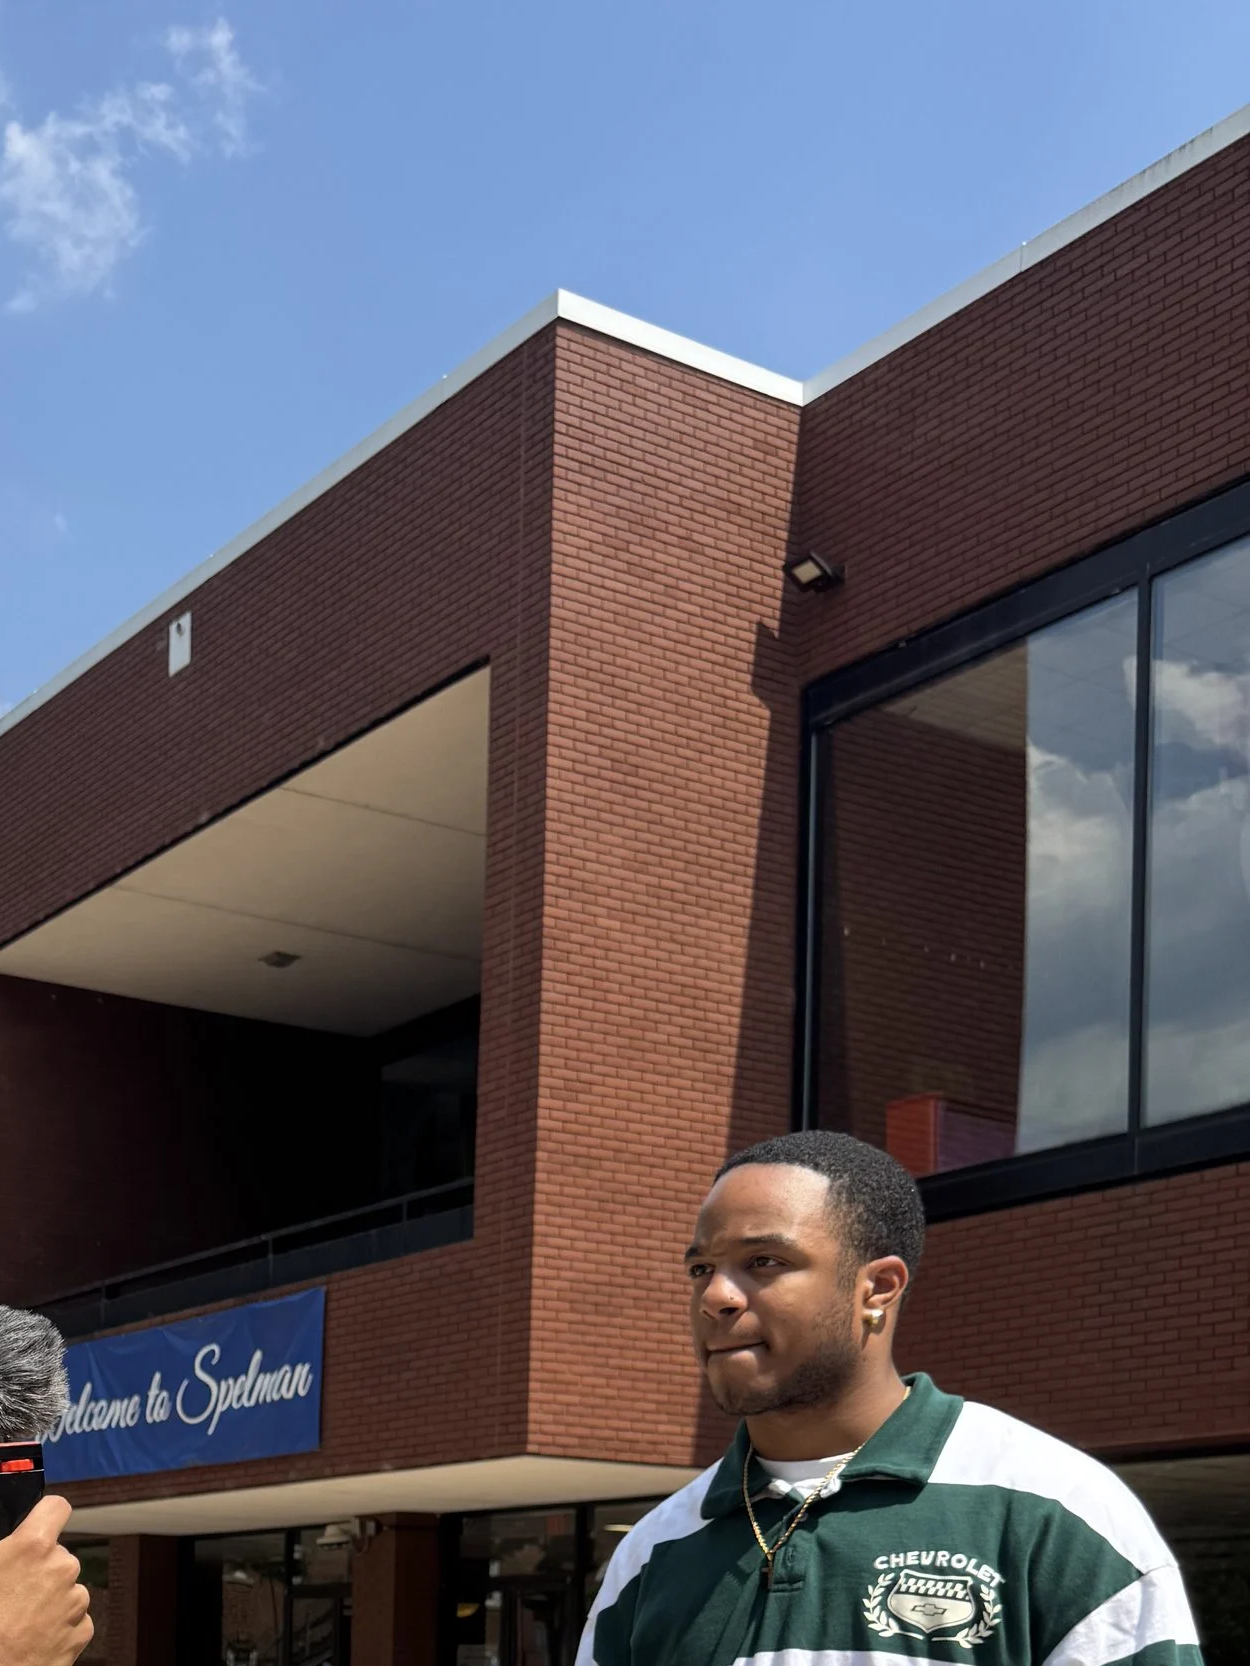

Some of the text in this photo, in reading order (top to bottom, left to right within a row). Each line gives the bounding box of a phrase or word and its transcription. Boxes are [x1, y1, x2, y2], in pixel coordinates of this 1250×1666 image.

[35, 1343, 313, 1443] elcome to Spelman
[873, 1550, 1006, 1588] CHEVROLET
